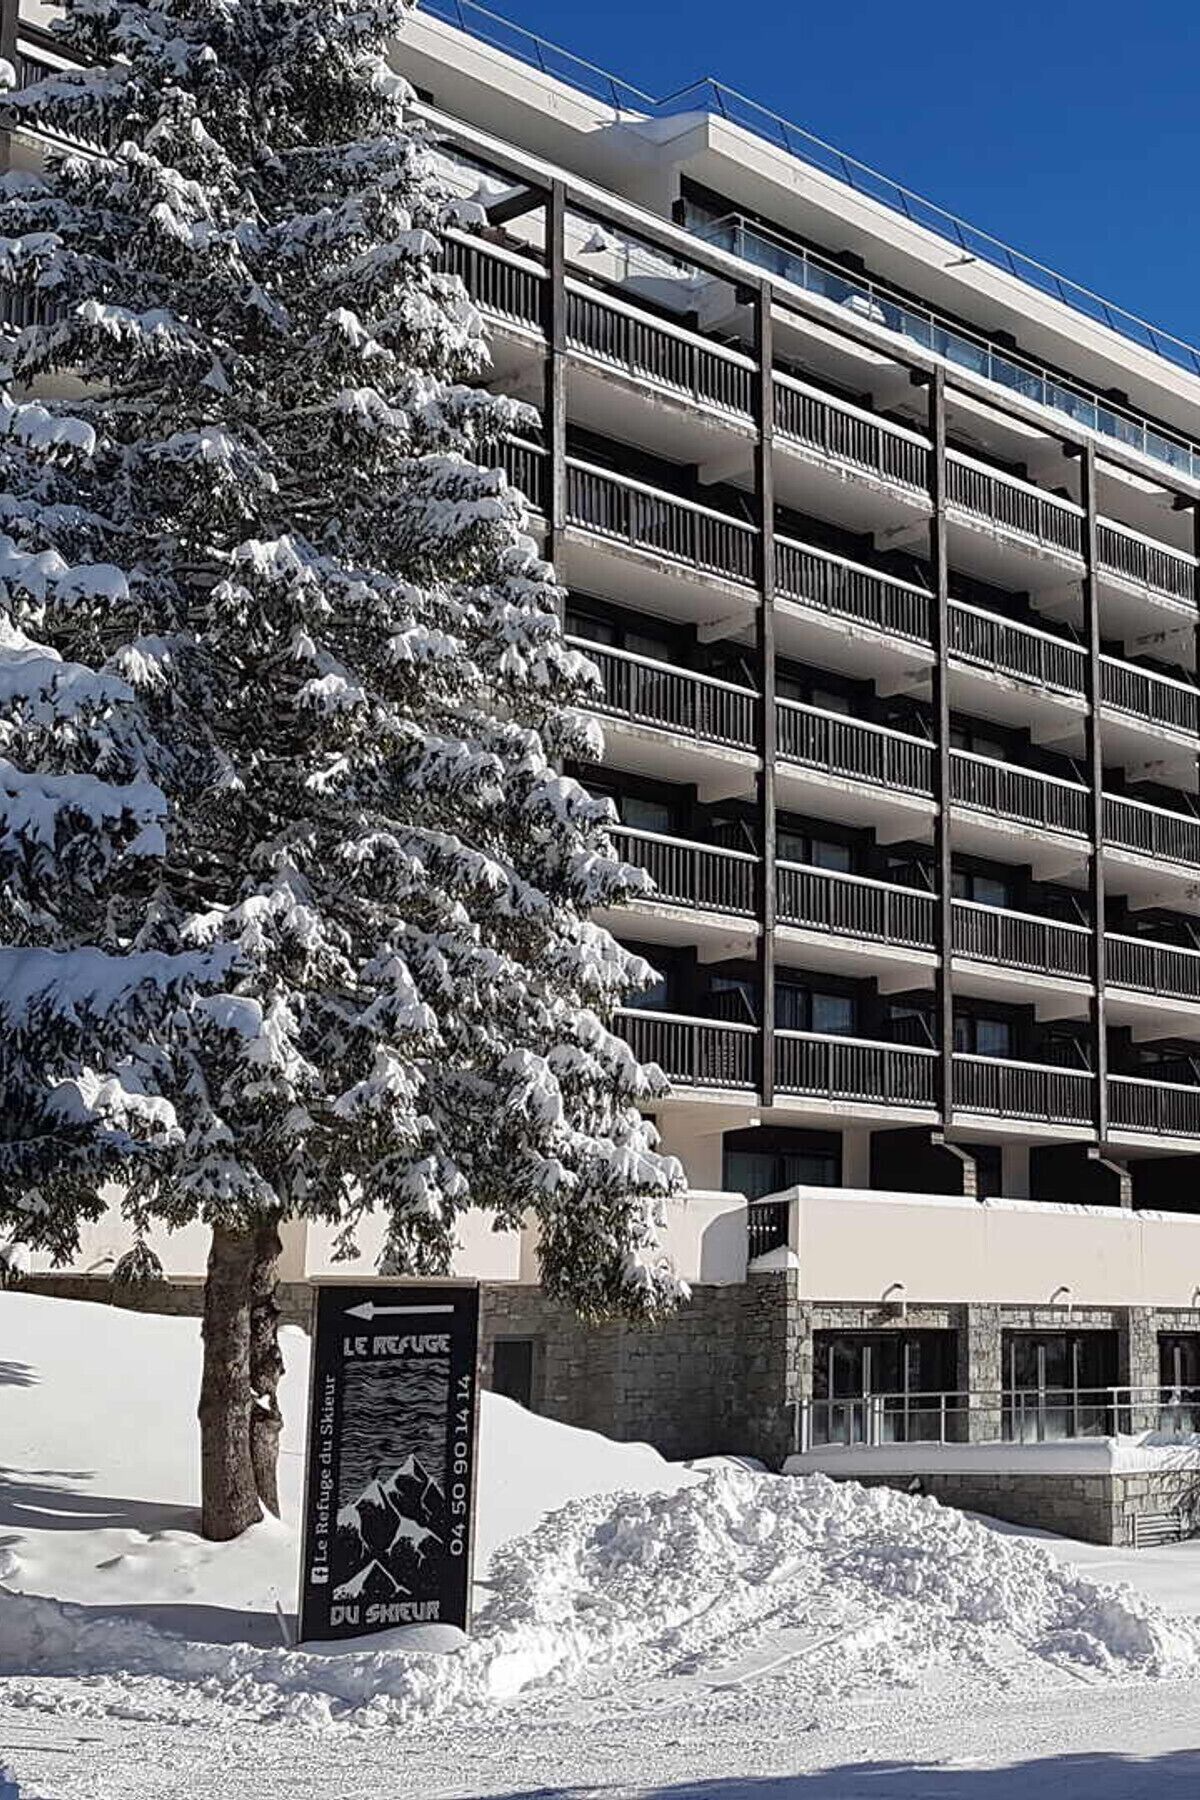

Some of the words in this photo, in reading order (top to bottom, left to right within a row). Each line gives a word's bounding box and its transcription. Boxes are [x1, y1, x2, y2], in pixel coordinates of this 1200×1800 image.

[343, 1336, 367, 1356] LE
[373, 1334, 450, 1355] REFUGE
[456, 1374, 471, 1400] 14
[320, 1374, 336, 1435] Skieur
[455, 1408, 470, 1434] 14
[319, 1440, 332, 1464] du
[453, 1441, 468, 1474] 90
[315, 1468, 334, 1534] Refuge
[452, 1483, 467, 1515] 50
[315, 1540, 328, 1562] Le
[450, 1522, 466, 1556] 04
[330, 1603, 360, 1626] DU
[366, 1600, 440, 1624] SKIEUR
